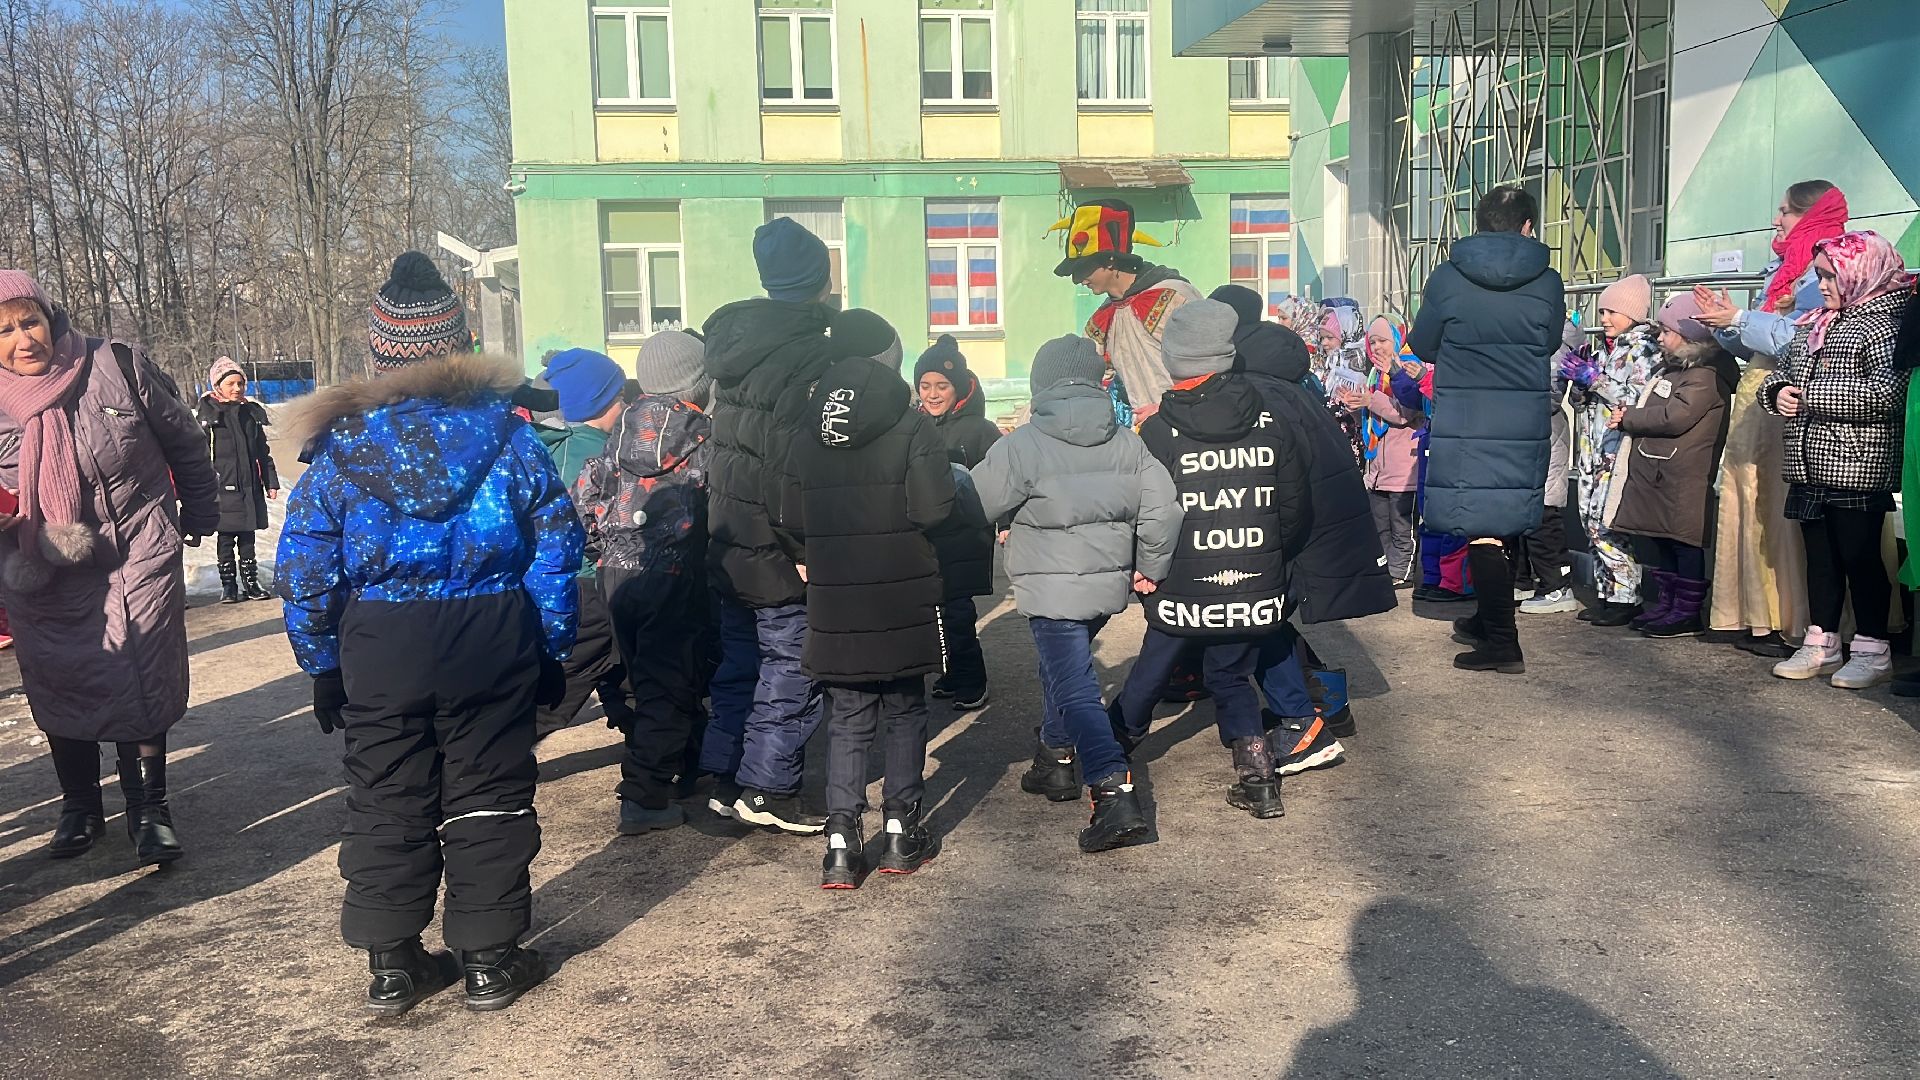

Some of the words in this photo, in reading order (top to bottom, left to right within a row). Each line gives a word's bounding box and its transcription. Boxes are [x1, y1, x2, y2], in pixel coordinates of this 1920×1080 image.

[828, 388, 855, 447] GALA
[1180, 446, 1275, 475] SOUND
[1182, 487, 1248, 512] PLAY
[1254, 486, 1275, 507] IT
[1193, 527, 1264, 551] LOUD
[1157, 593, 1285, 628] ENERGY
